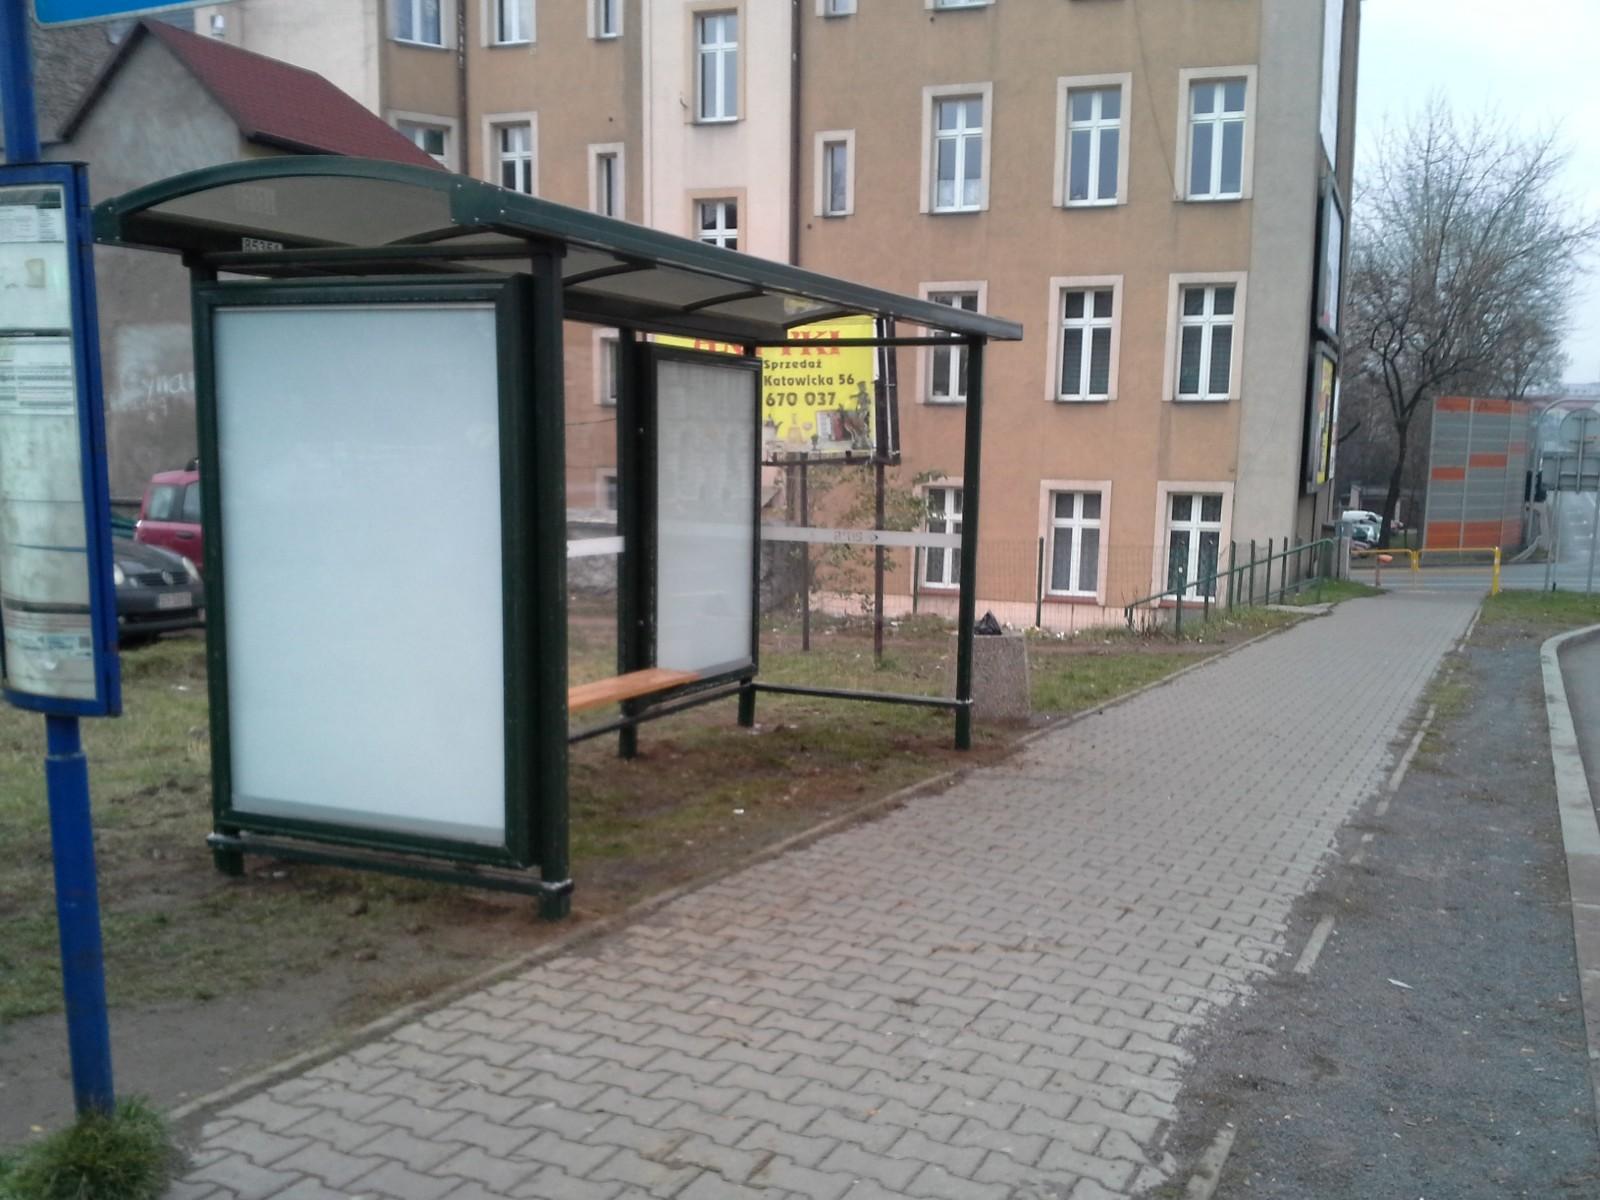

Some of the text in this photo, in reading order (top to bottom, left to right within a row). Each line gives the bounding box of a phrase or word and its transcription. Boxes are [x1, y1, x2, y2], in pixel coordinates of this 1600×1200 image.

[763, 359, 822, 371] Sprzedaż
[763, 374, 855, 386] Katowicka 56
[766, 392, 836, 406] 670 037
